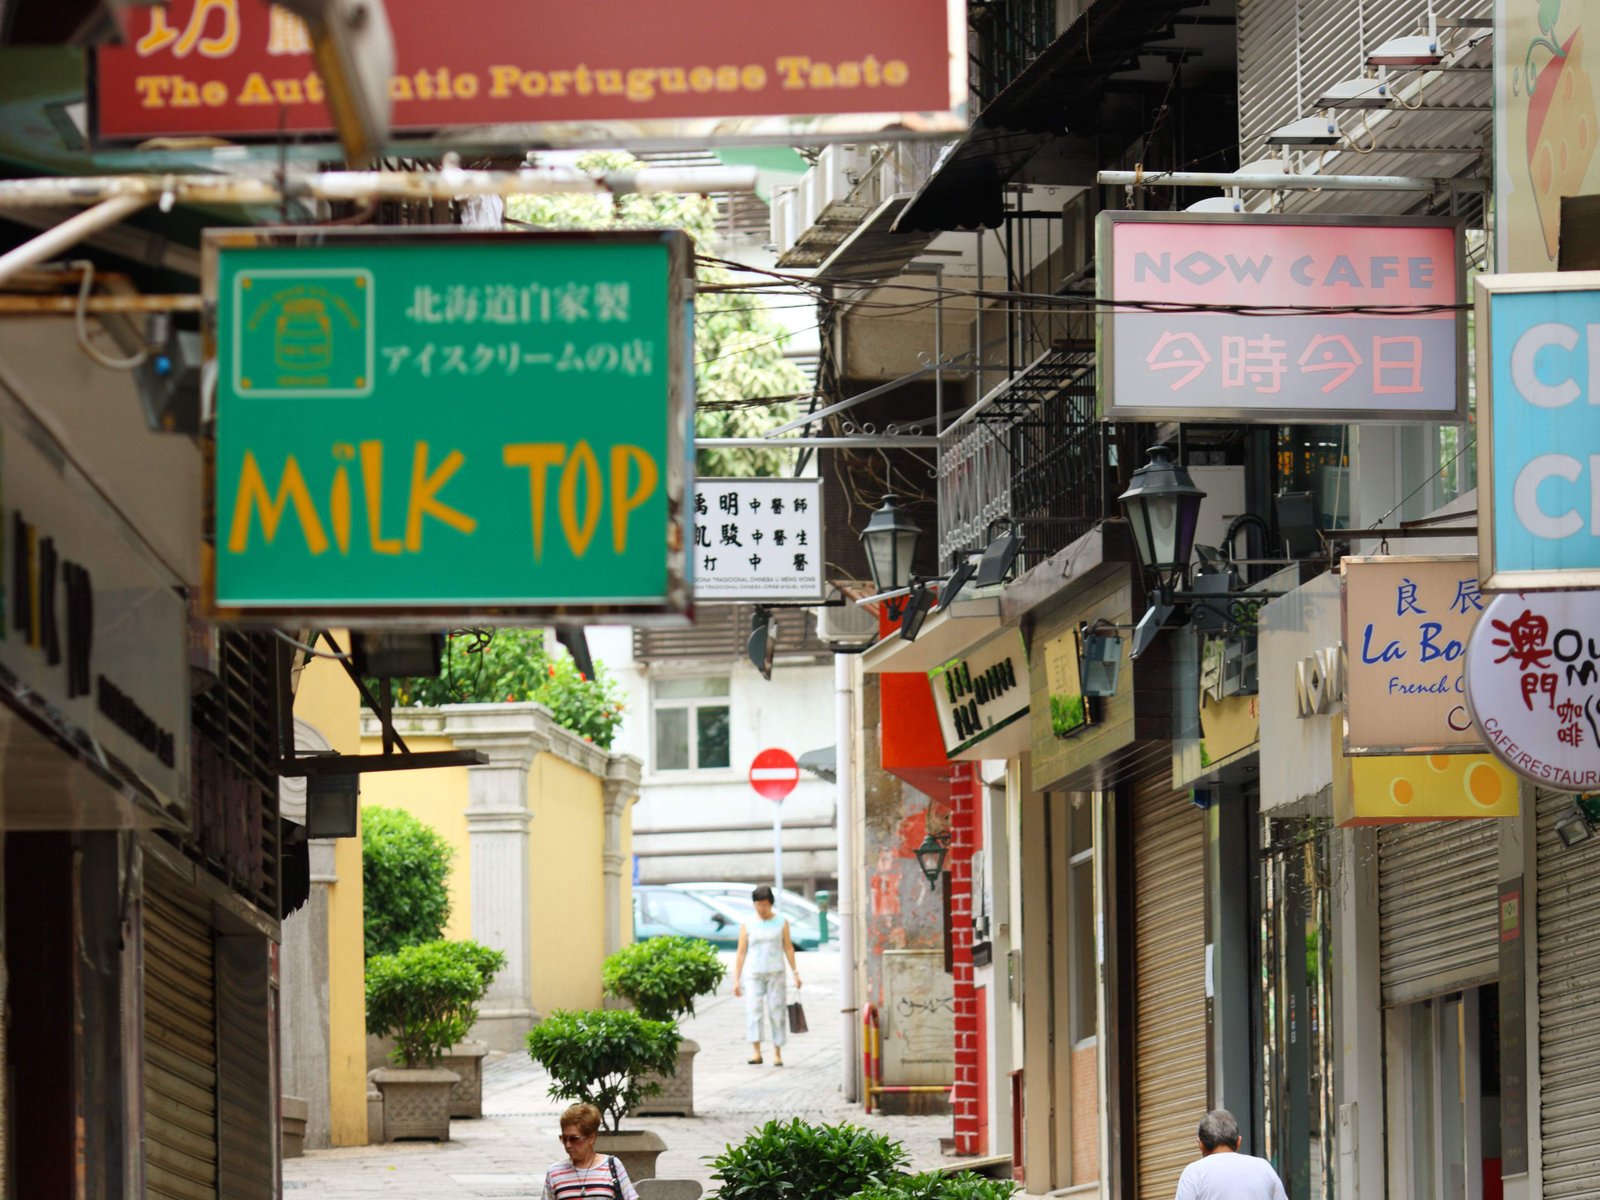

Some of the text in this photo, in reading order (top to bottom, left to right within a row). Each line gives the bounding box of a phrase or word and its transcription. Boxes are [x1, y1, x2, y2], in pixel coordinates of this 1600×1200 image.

[136, 54, 909, 107] The Autntic Portuguese Taste
[1133, 251, 1435, 289] NOW CAFE
[1146, 330, 1424, 394] 今時今日
[1510, 322, 1600, 408] C
[503, 438, 658, 566] TOP
[1513, 453, 1600, 540] C
[1362, 623, 1407, 665] La
[1389, 675, 1449, 695] French
